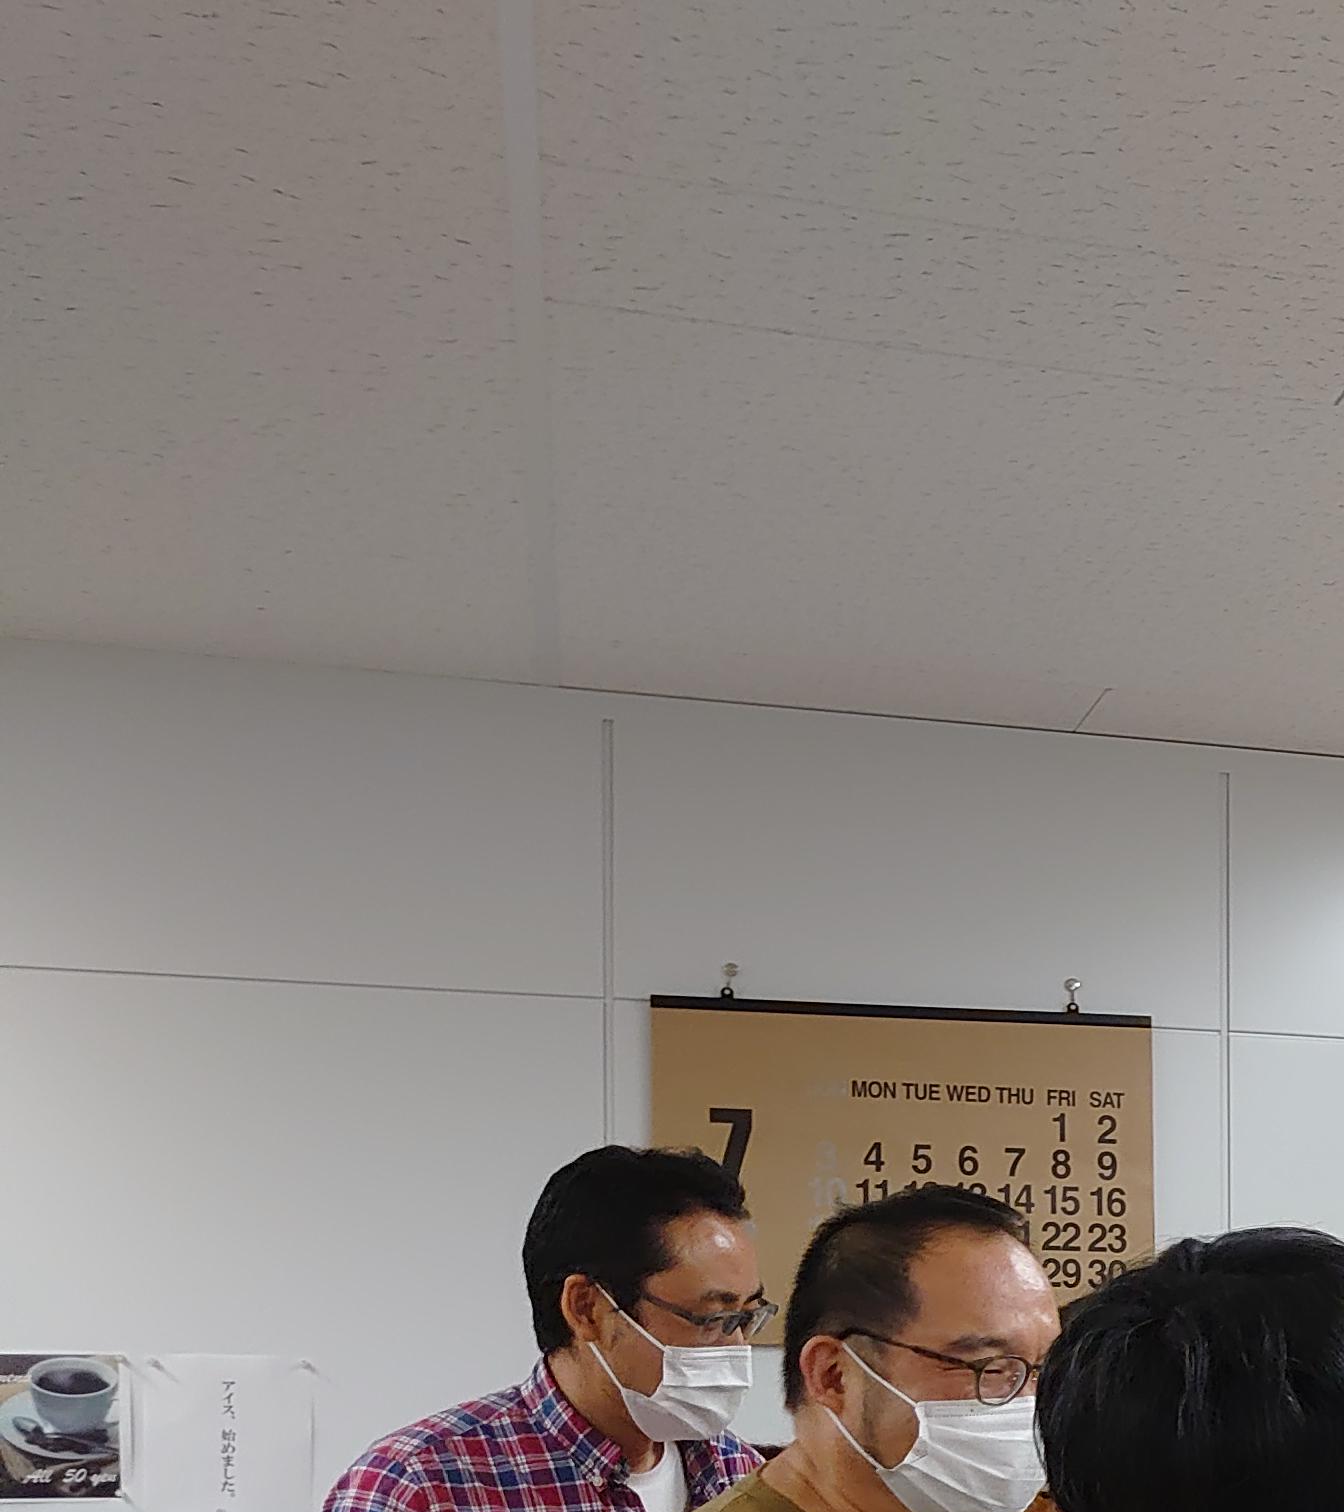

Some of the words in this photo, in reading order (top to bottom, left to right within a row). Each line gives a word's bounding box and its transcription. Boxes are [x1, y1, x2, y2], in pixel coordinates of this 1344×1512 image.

[851, 1080, 896, 1098] MON
[901, 1082, 941, 1100] TUE
[946, 1085, 991, 1102] WED
[996, 1087, 1034, 1105] THU
[1047, 1089, 1076, 1107] FRI
[1089, 1091, 1125, 1108] SAT
[709, 1107, 753, 1182] 7
[1052, 1113, 1067, 1142] 1
[1097, 1115, 1118, 1145] 2
[863, 1142, 885, 1172] 4
[911, 1144, 932, 1174] 5
[958, 1145, 979, 1176] 6
[1004, 1147, 1026, 1177] 7
[1051, 1149, 1072, 1180] 8
[1097, 1151, 1118, 1181] 9
[997, 1183, 1035, 1214] 14
[1044, 1185, 1081, 1216] 15
[1090, 1187, 1127, 1218] 16
[1041, 1221, 1081, 1252] 22
[1088, 1223, 1128, 1253] 23
[1042, 1258, 1082, 1289] 29
[22, 1468, 54, 1485] All
[62, 1468, 88, 1483] 50
